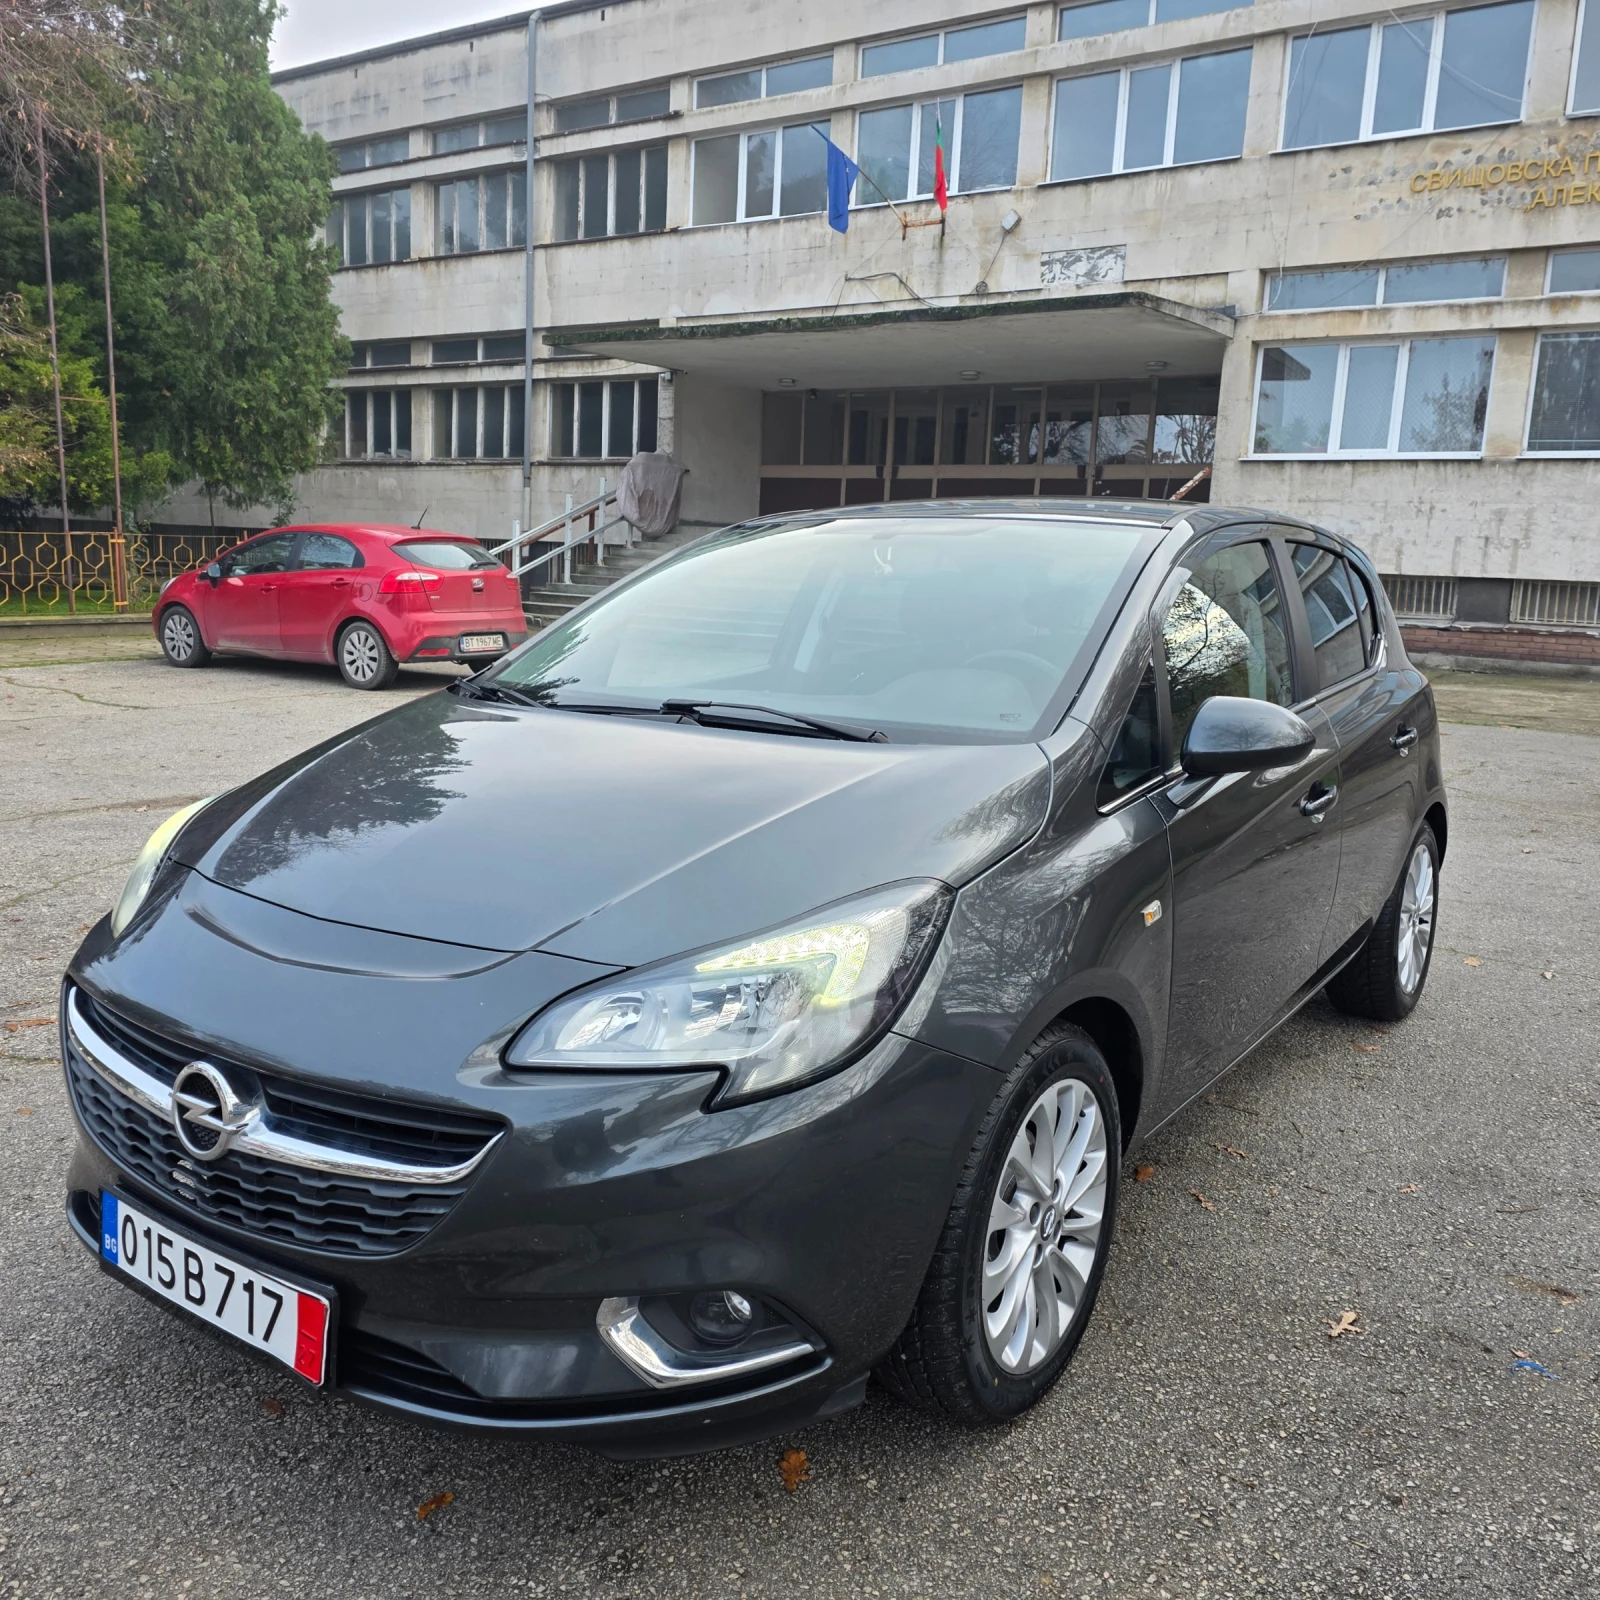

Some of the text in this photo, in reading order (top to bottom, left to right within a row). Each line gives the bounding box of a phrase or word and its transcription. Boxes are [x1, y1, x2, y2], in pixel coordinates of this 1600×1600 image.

[1410, 155, 1575, 193] СВИЩОВСКА
[104, 1233, 117, 1254] BG
[121, 1213, 284, 1343] 015B717
